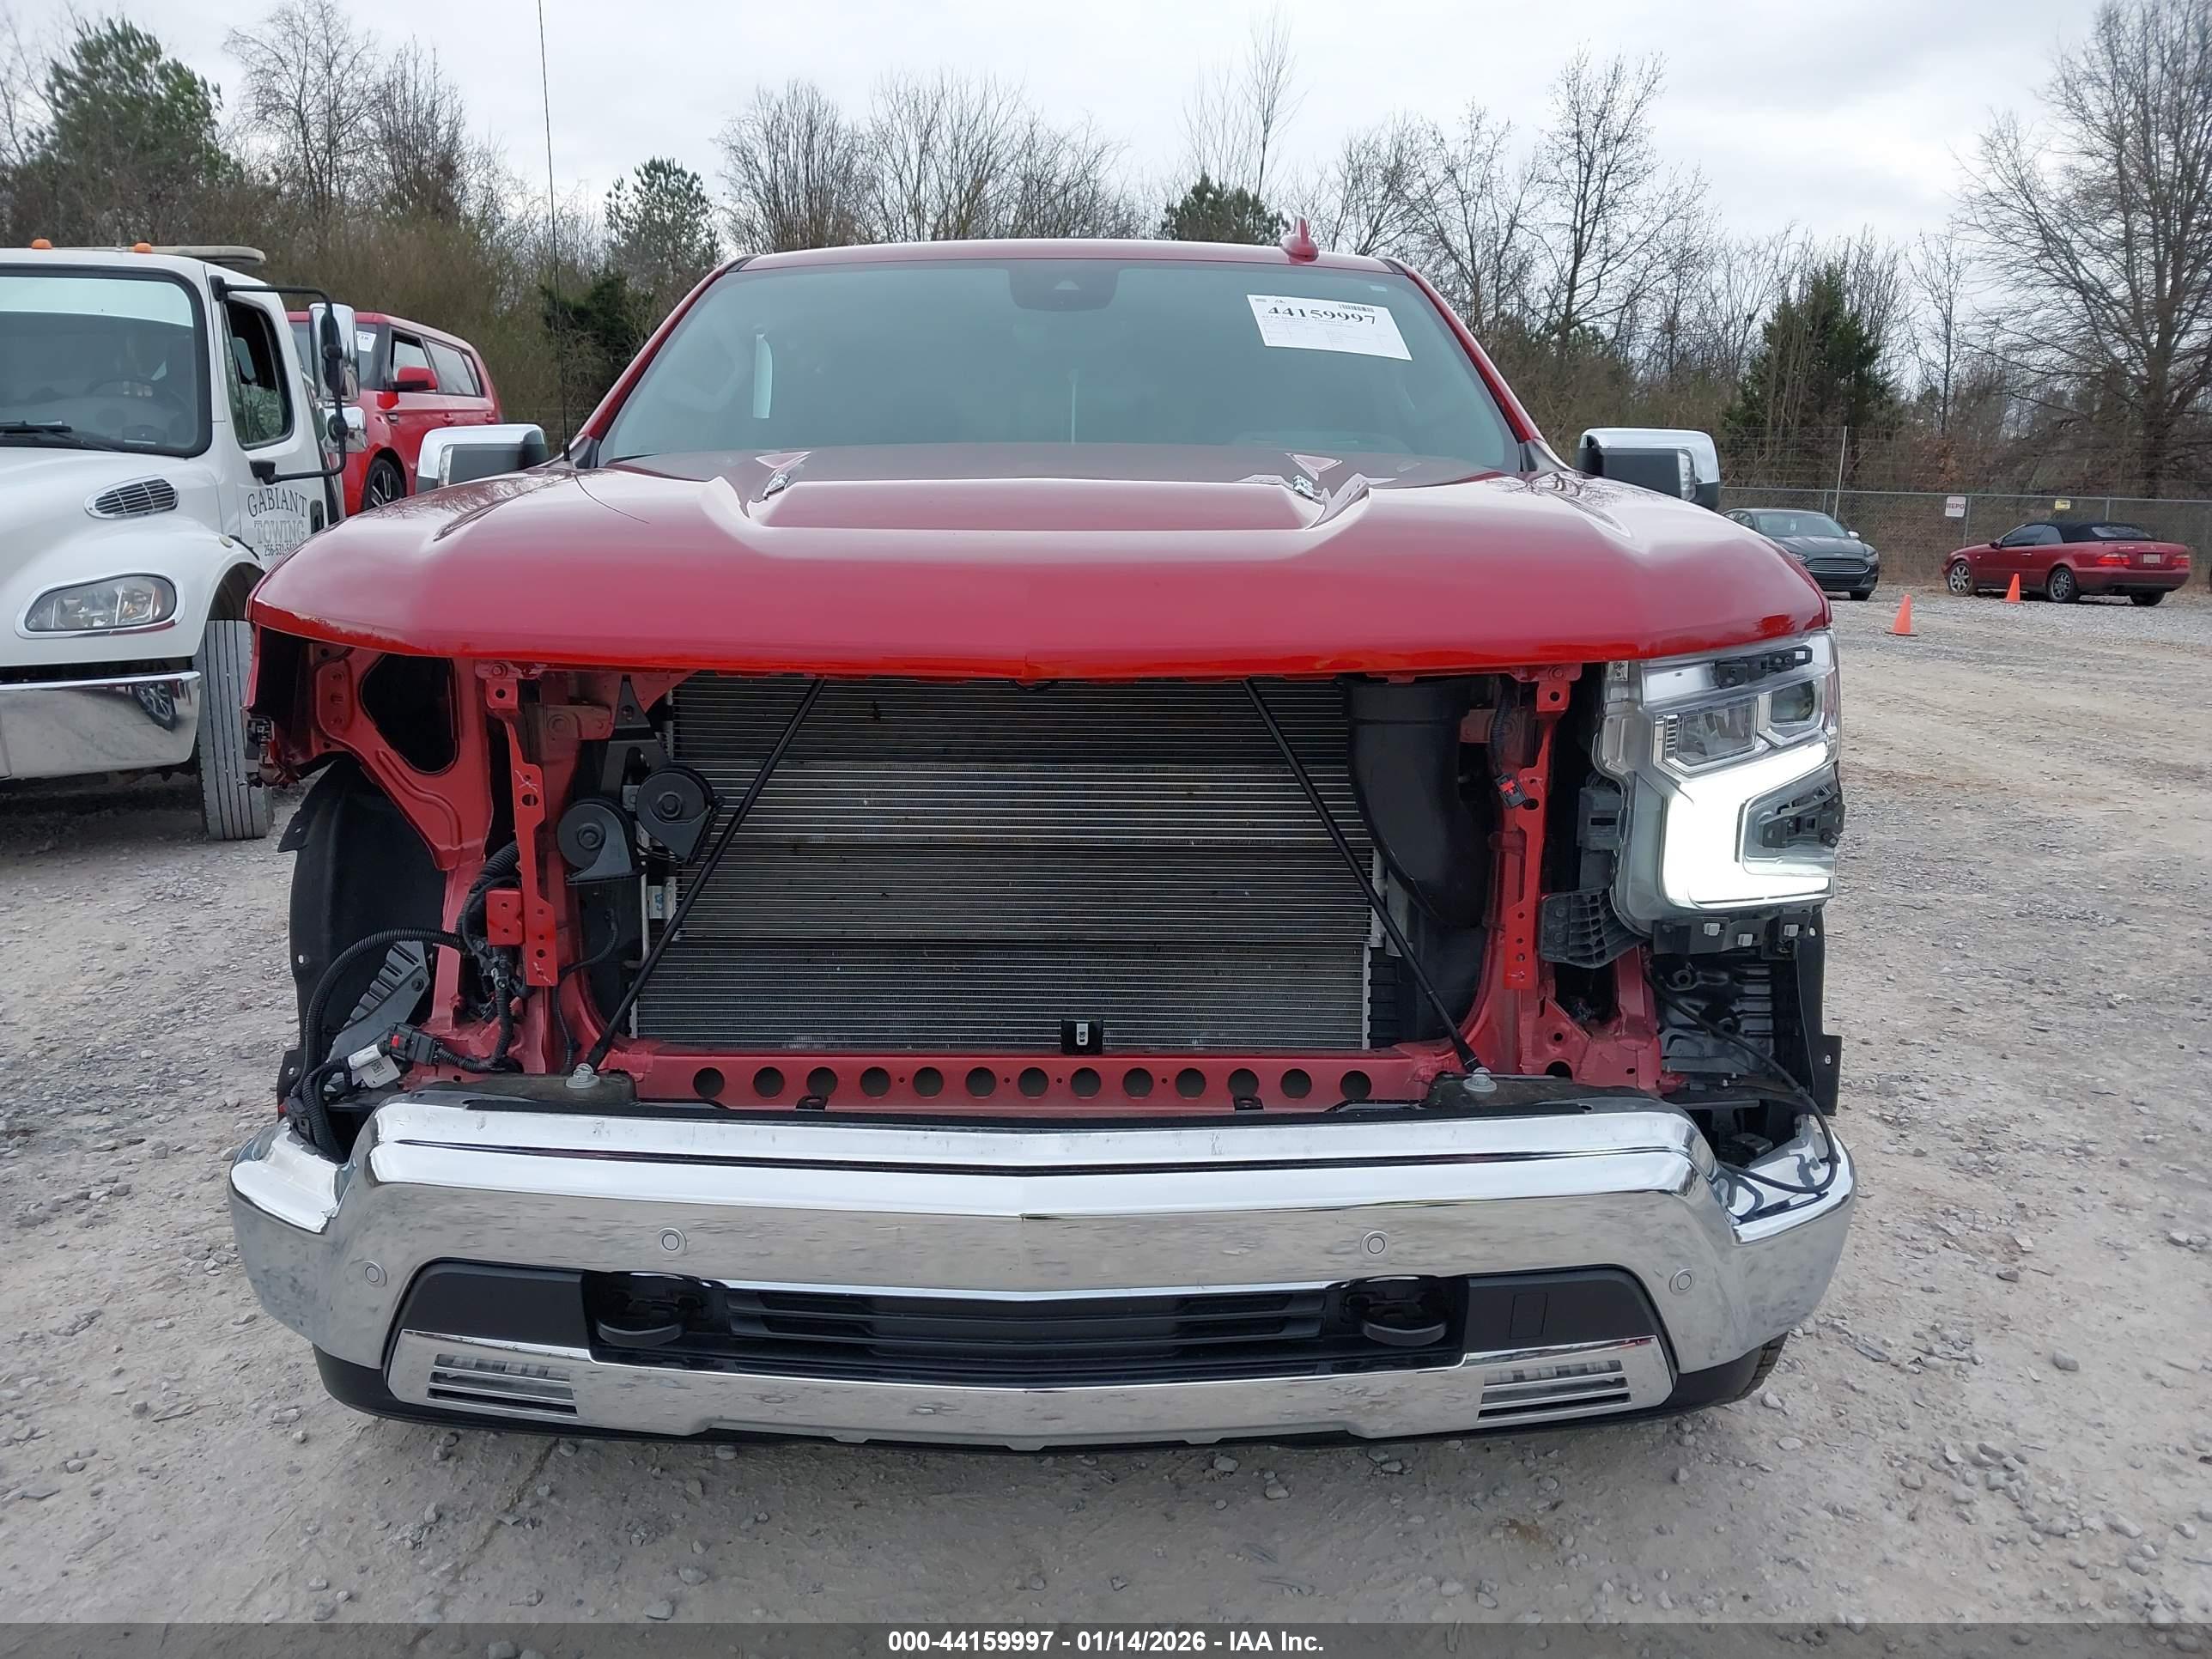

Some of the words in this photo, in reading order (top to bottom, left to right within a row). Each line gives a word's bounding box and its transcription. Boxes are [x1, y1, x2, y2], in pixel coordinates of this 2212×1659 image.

[1267, 307, 1376, 325] 44159997
[247, 487, 307, 517] GABIANT
[253, 520, 306, 544] TOWING
